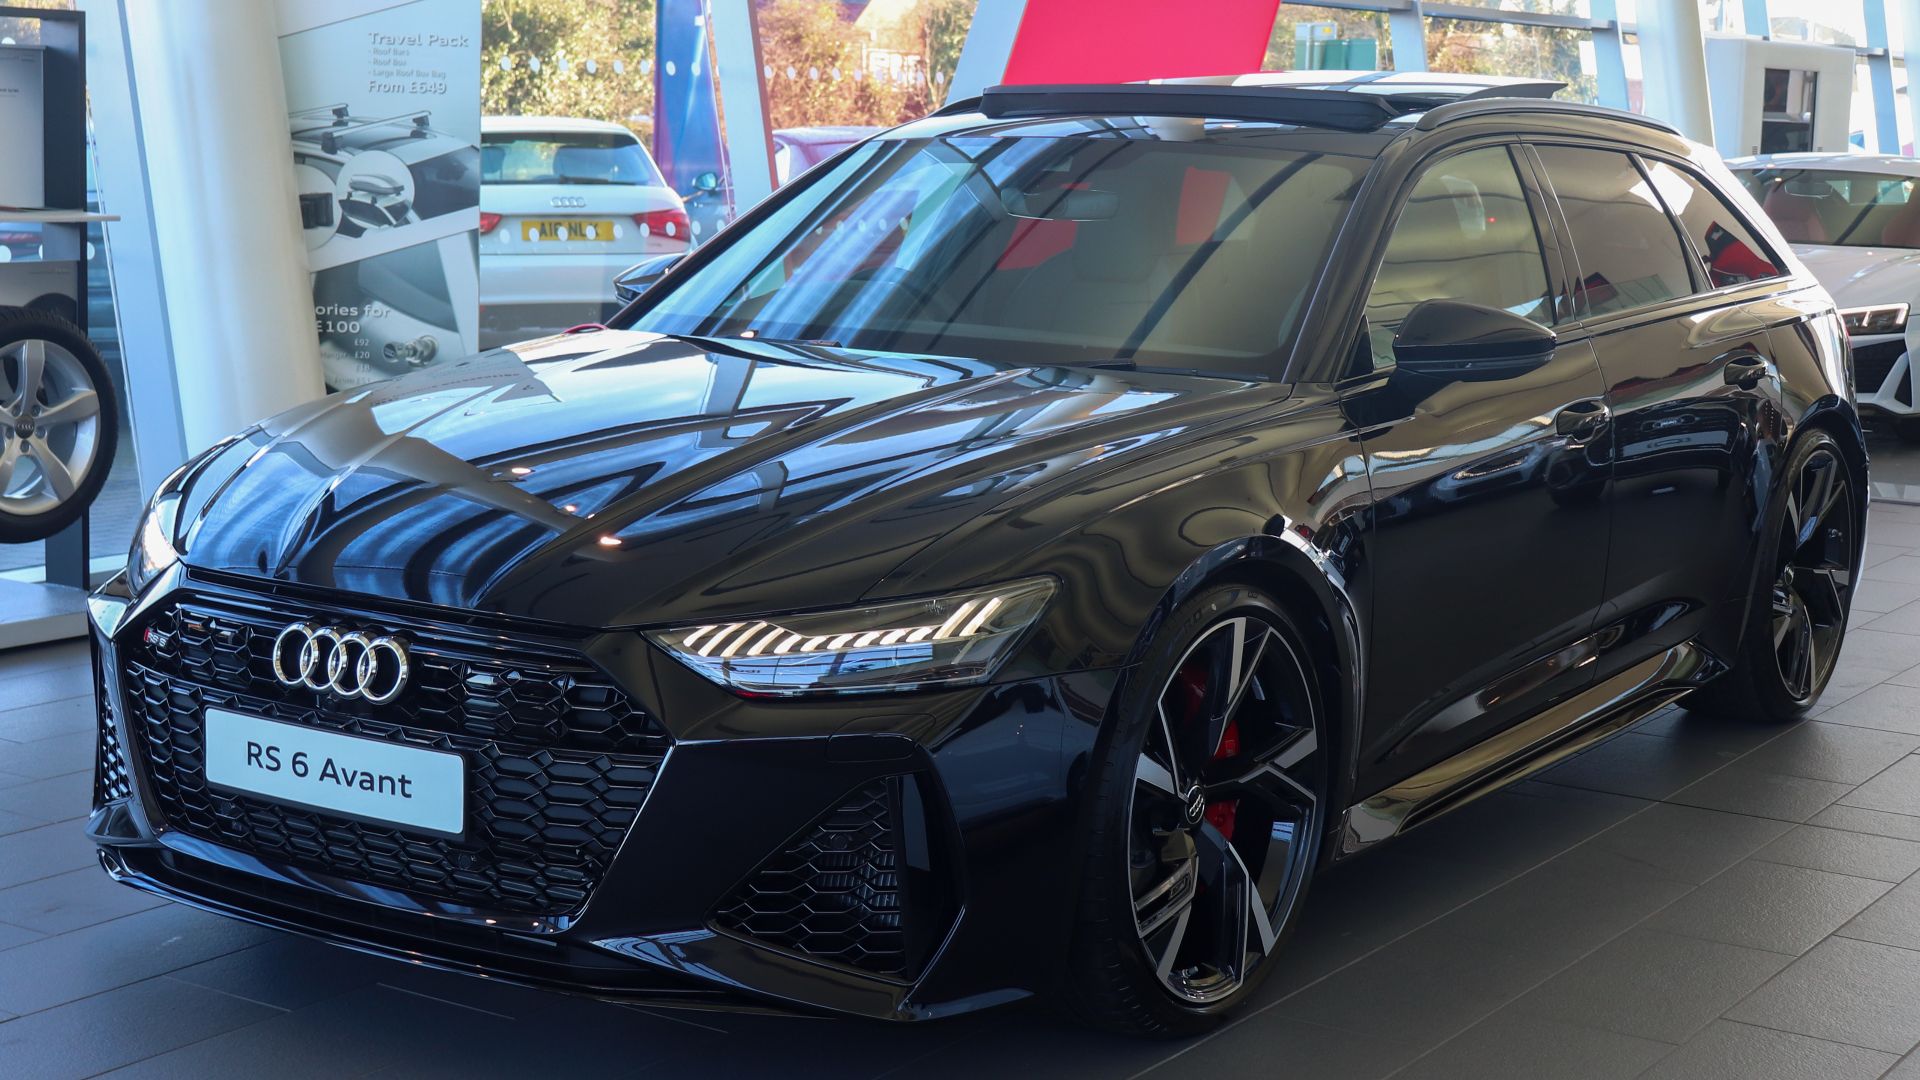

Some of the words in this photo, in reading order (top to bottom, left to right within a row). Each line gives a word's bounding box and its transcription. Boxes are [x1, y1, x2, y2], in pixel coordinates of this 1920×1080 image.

[368, 32, 423, 46] Travel
[428, 33, 469, 47] Pack
[368, 80, 405, 93] From
[408, 81, 447, 95] £649
[363, 304, 391, 318] for
[354, 351, 370, 359] £20
[246, 740, 282, 772] RS
[291, 751, 309, 778] 6
[318, 757, 413, 799] Avant
